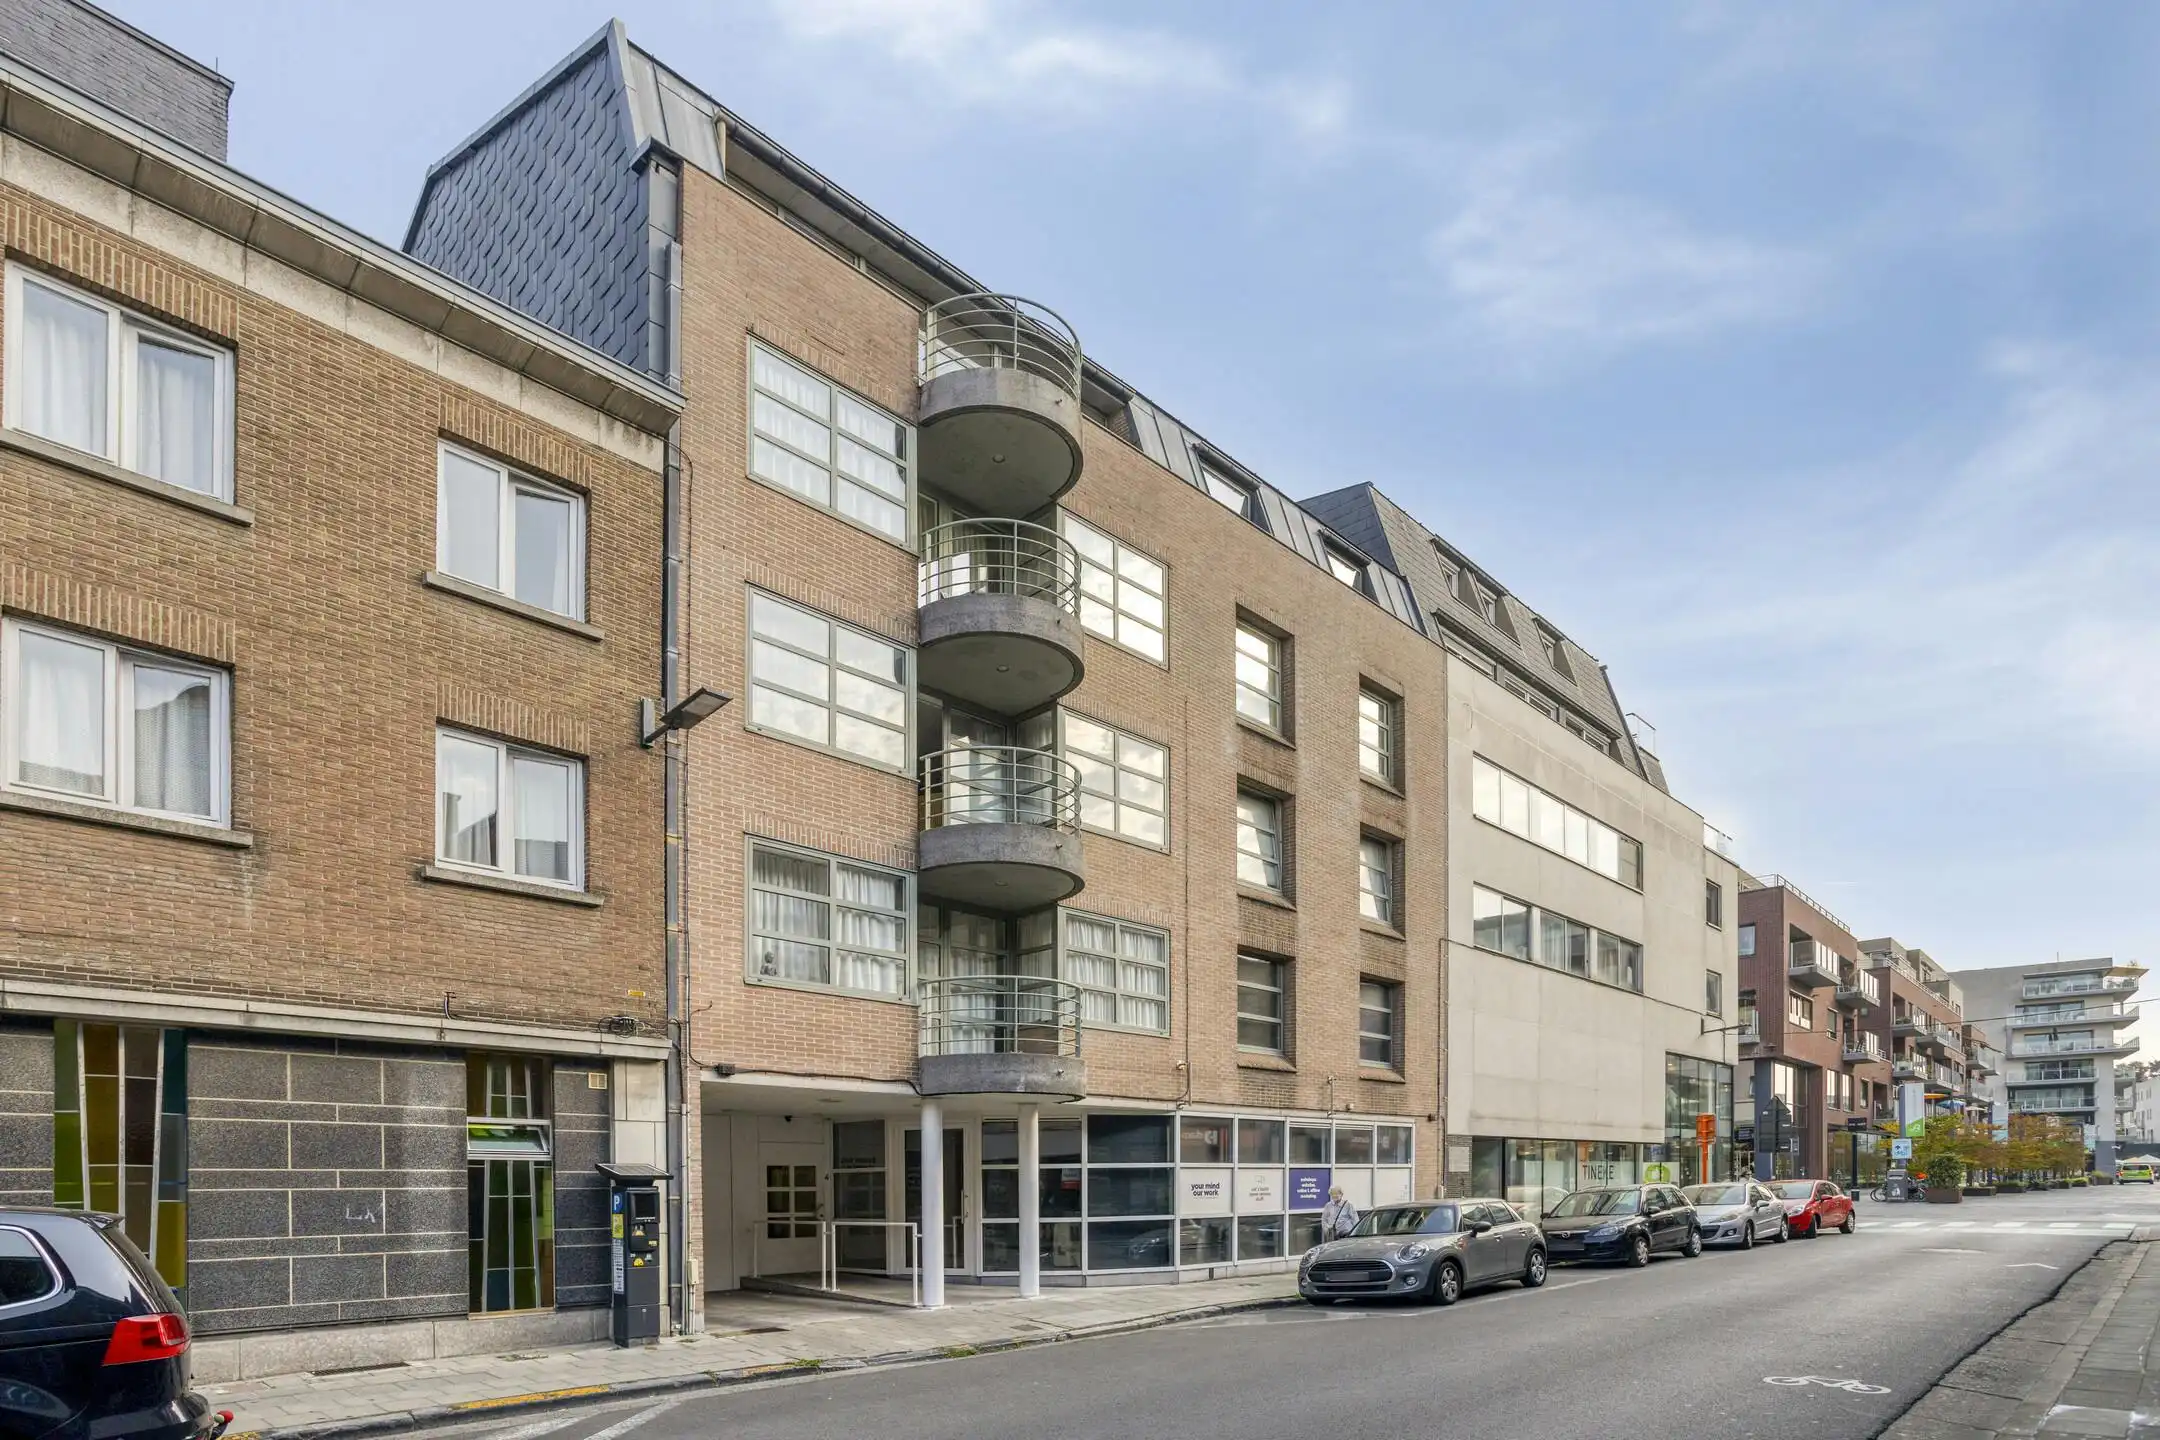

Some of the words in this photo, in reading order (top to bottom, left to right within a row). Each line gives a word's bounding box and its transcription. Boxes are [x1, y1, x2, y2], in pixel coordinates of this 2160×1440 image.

[1190, 1182, 1204, 1191] your
[1205, 1182, 1220, 1190] mind
[613, 1195, 620, 1211] P
